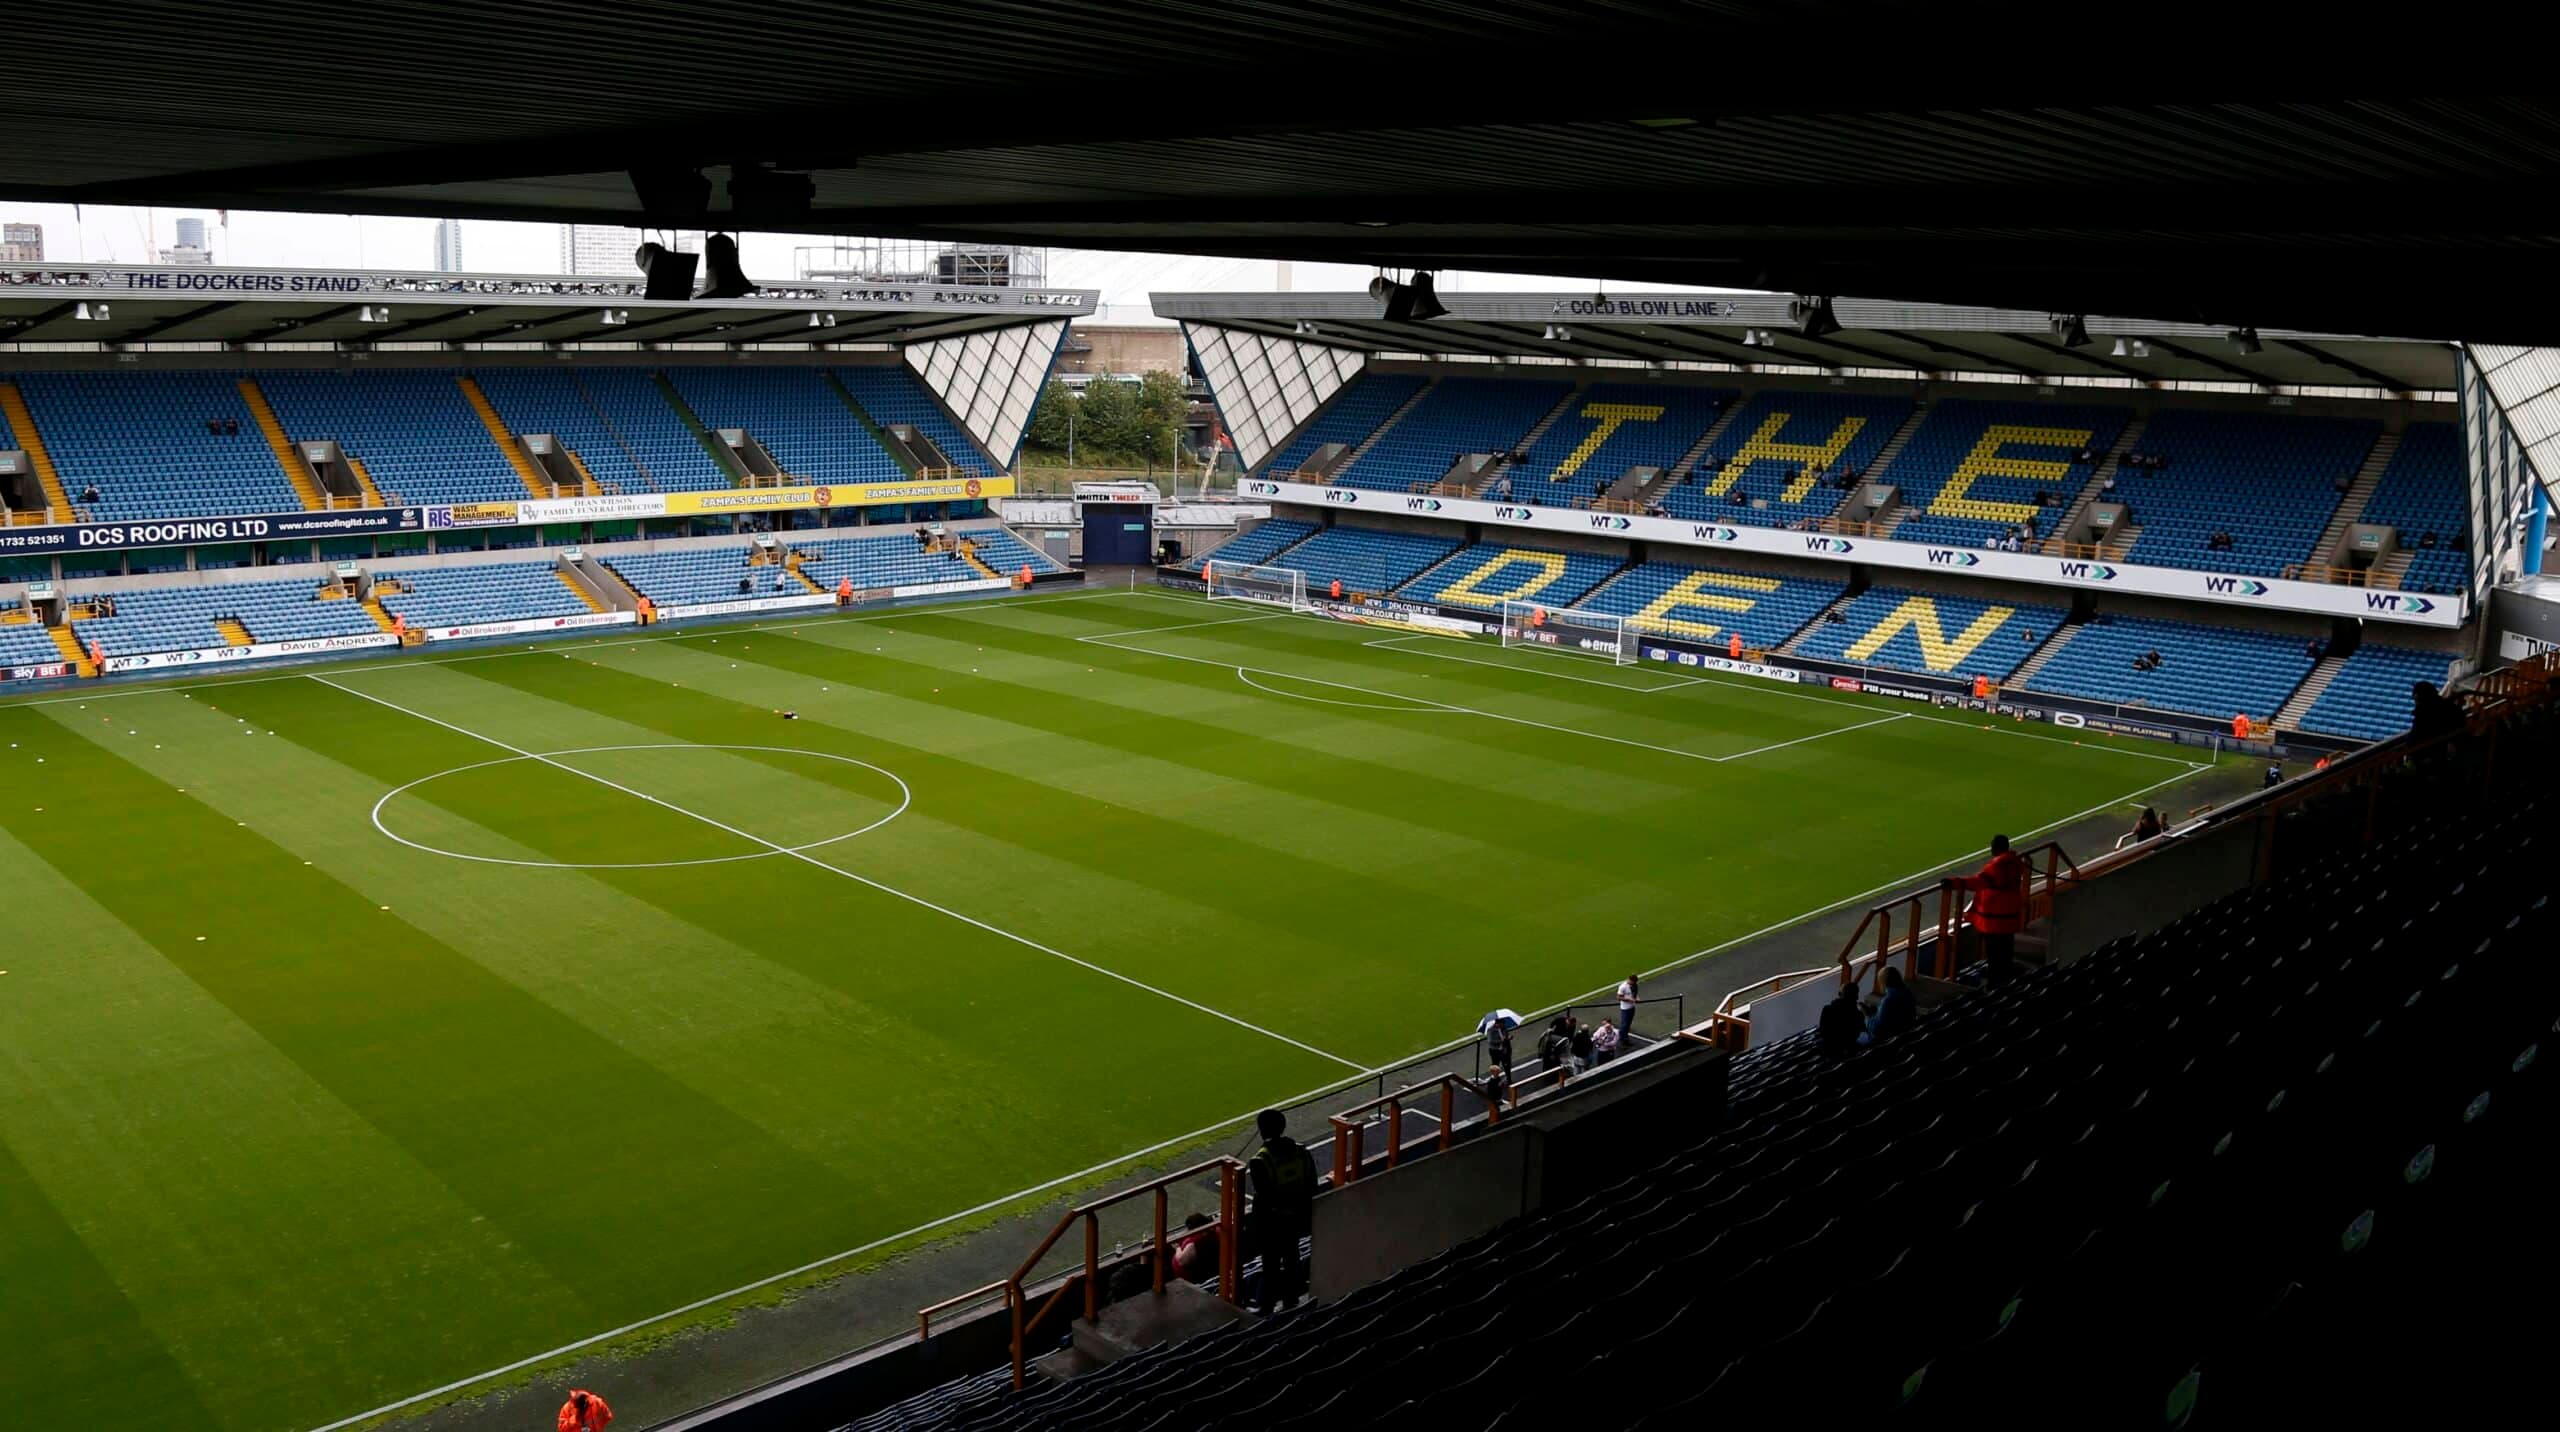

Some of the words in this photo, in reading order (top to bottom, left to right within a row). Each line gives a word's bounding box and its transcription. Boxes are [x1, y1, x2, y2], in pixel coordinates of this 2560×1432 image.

[124, 272, 170, 289] THE
[176, 273, 285, 291] DOCKERS
[291, 275, 361, 292] STAND
[1620, 301, 1670, 315] BLOW
[1674, 302, 1719, 316] LANE
[1550, 403, 2094, 523] THE
[905, 486, 937, 497] FAMILY
[939, 484, 962, 495] CLUB
[1250, 482, 1265, 493] WT
[601, 497, 633, 505] WILSON
[747, 494, 782, 505] FAMILY
[784, 493, 810, 504] CLUB
[1325, 490, 1342, 501] WT
[452, 504, 478, 512] WASTE
[543, 507, 574, 517] FAMILY
[577, 505, 614, 514] FUNERAL
[617, 502, 664, 512] DIRECTORS
[1407, 497, 1425, 510] WT
[428, 507, 452, 527] RTS
[453, 510, 506, 520] MANAGEMENT
[1495, 506, 1515, 519] WT
[278, 516, 389, 531] www.dcsroofingltd.co.uk
[1590, 515, 1610, 528] WT
[79, 527, 125, 546] DCS
[130, 522, 227, 543] ROOFING
[232, 519, 269, 538] LTD
[1694, 525, 1716, 539] WT
[27, 535, 65, 546] 521351
[1806, 536, 1830, 551] WT
[1927, 549, 1953, 564] WT
[2060, 562, 2089, 577] WT
[2206, 576, 2237, 592] WT
[2366, 593, 2400, 610] WT
[1435, 548, 2016, 672] DEN
[1486, 624, 1499, 635] sky
[1523, 630, 1537, 641] sky
[1539, 633, 1557, 643] BET
[281, 641, 320, 651] DAVID
[325, 635, 386, 648] ANDREWS
[166, 653, 184, 664] WT
[217, 647, 235, 658] WT
[15, 666, 35, 679] sky
[40, 665, 63, 676] BET
[1863, 684, 1879, 693] Fill
[1880, 687, 1902, 696] your
[1903, 689, 1929, 700] boots
[2087, 718, 2113, 729] AERIAL
[2113, 723, 2132, 732] WORK
[2132, 726, 2173, 739] PLATFORMS
